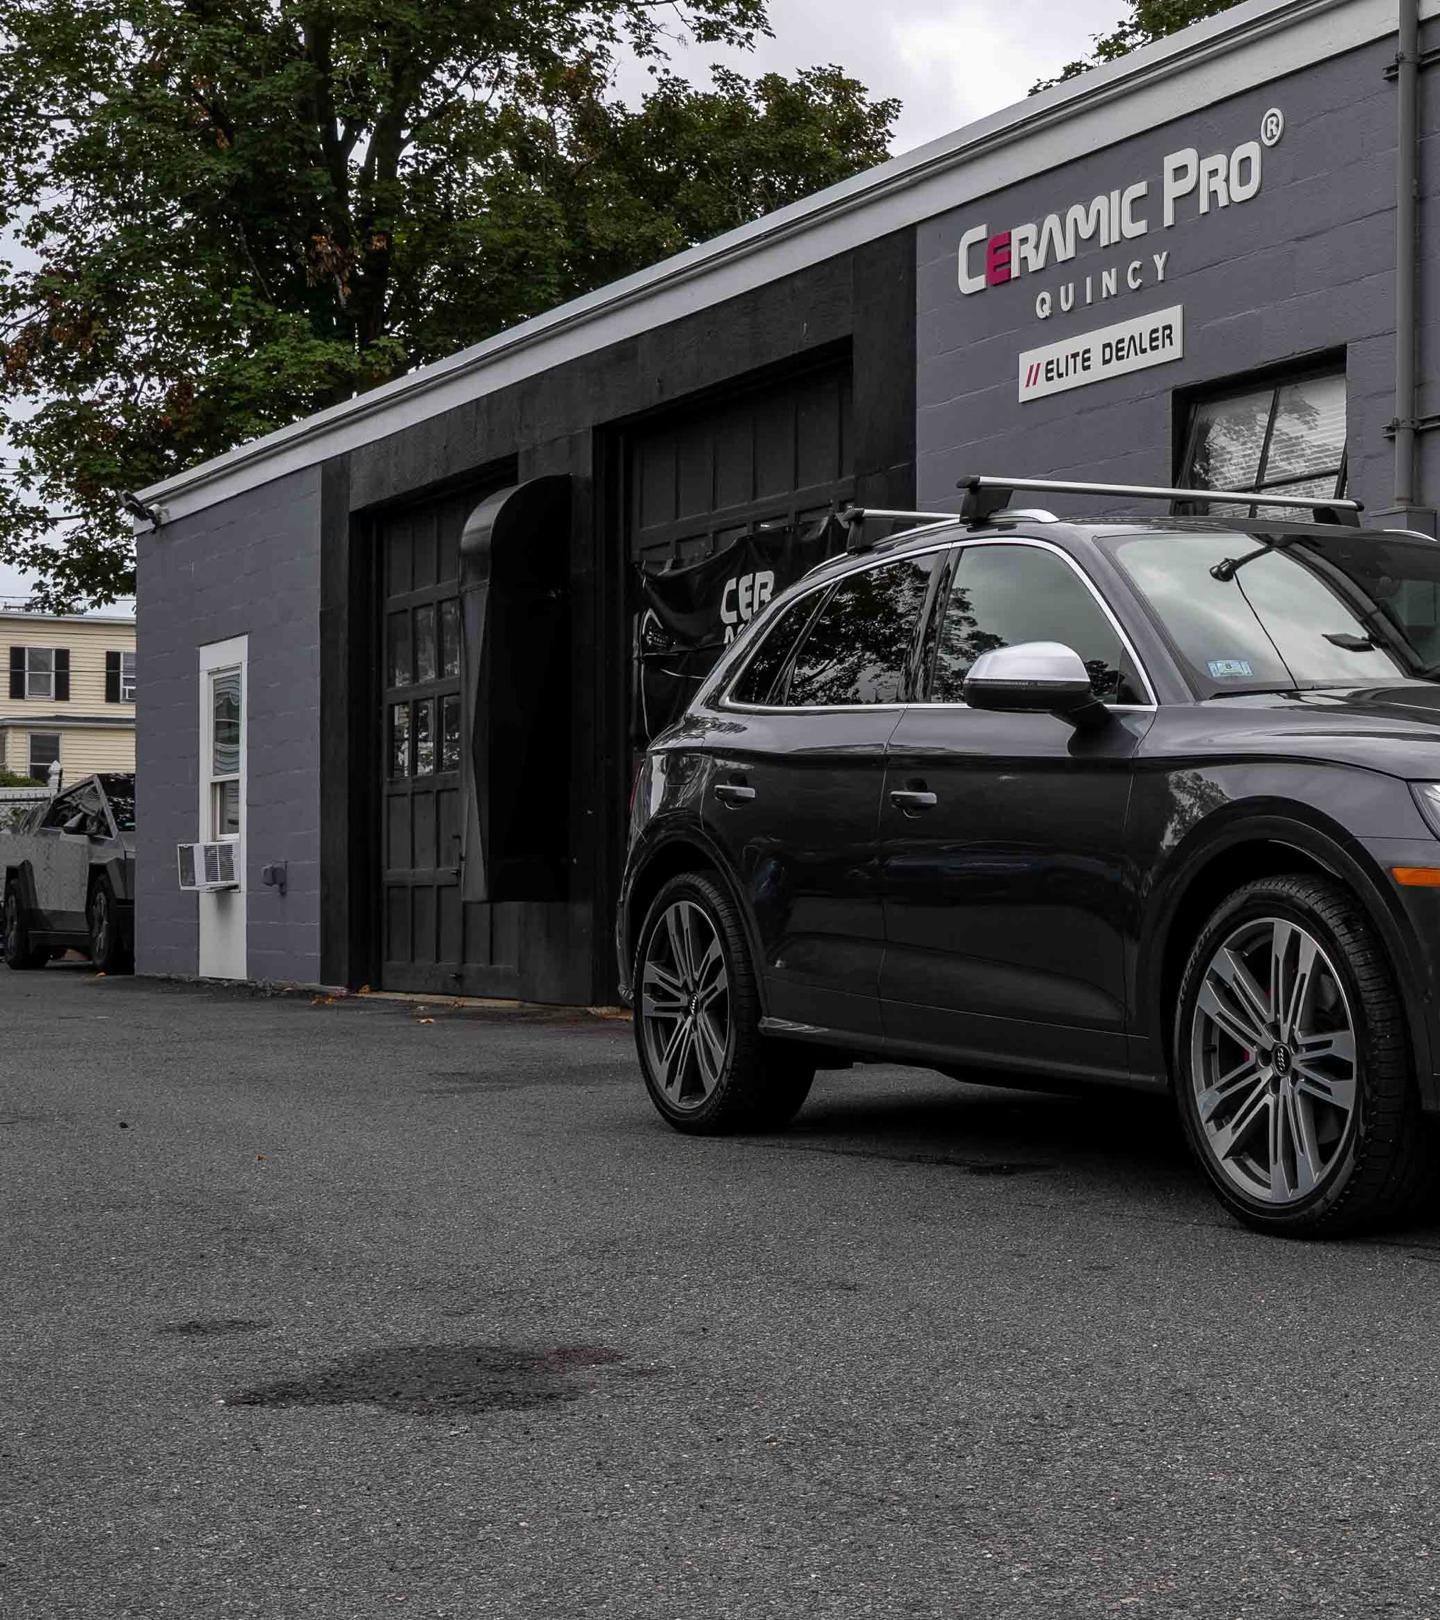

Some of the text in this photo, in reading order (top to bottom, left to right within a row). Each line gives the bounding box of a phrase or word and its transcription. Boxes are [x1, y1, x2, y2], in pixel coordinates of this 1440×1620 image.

[958, 180, 1148, 295] CERAMIC
[1035, 251, 1169, 320] QUINCY
[1044, 323, 1174, 382] ELITE DEALER
